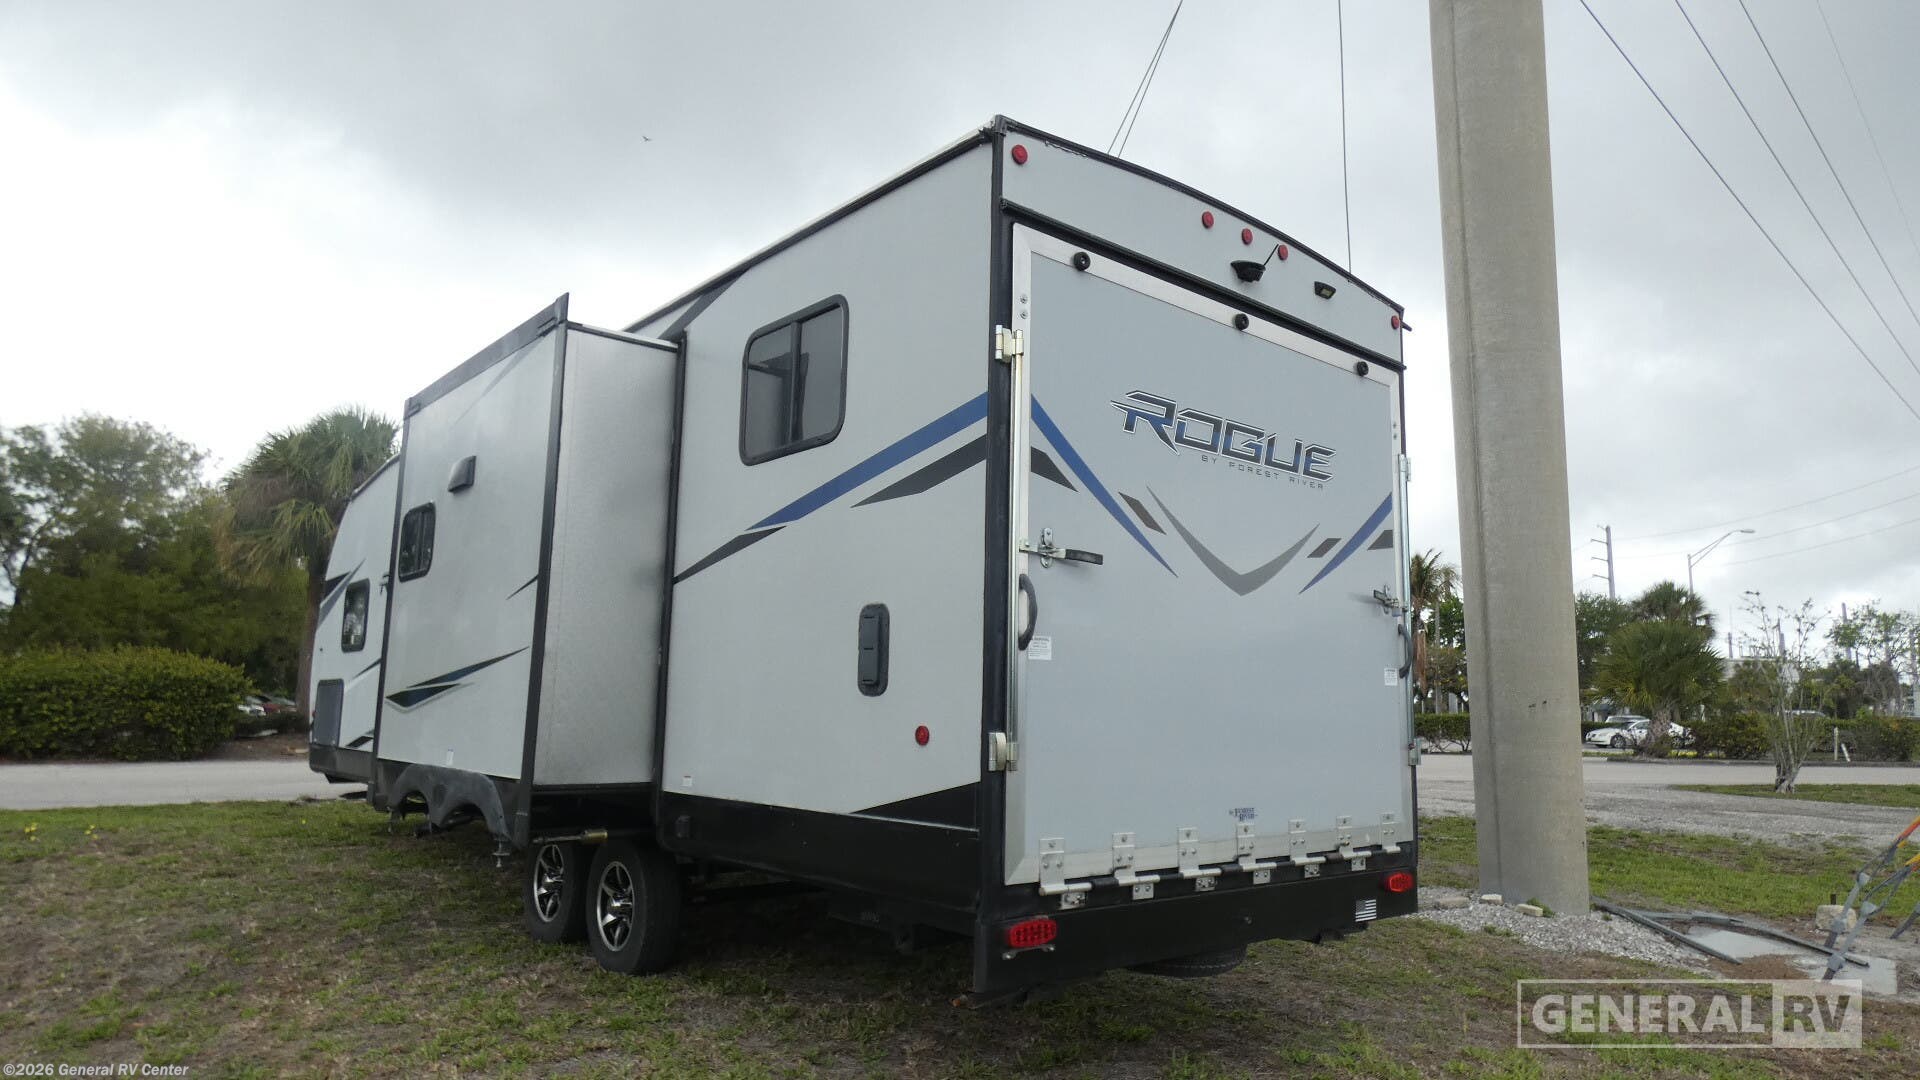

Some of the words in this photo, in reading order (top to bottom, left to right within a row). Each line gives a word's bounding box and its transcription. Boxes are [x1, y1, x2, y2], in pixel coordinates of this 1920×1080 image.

[1110, 390, 1336, 482] ROGUE
[1201, 454, 1217, 464] BY
[1229, 461, 1279, 480] FOREST
[1289, 476, 1323, 489] RIVER
